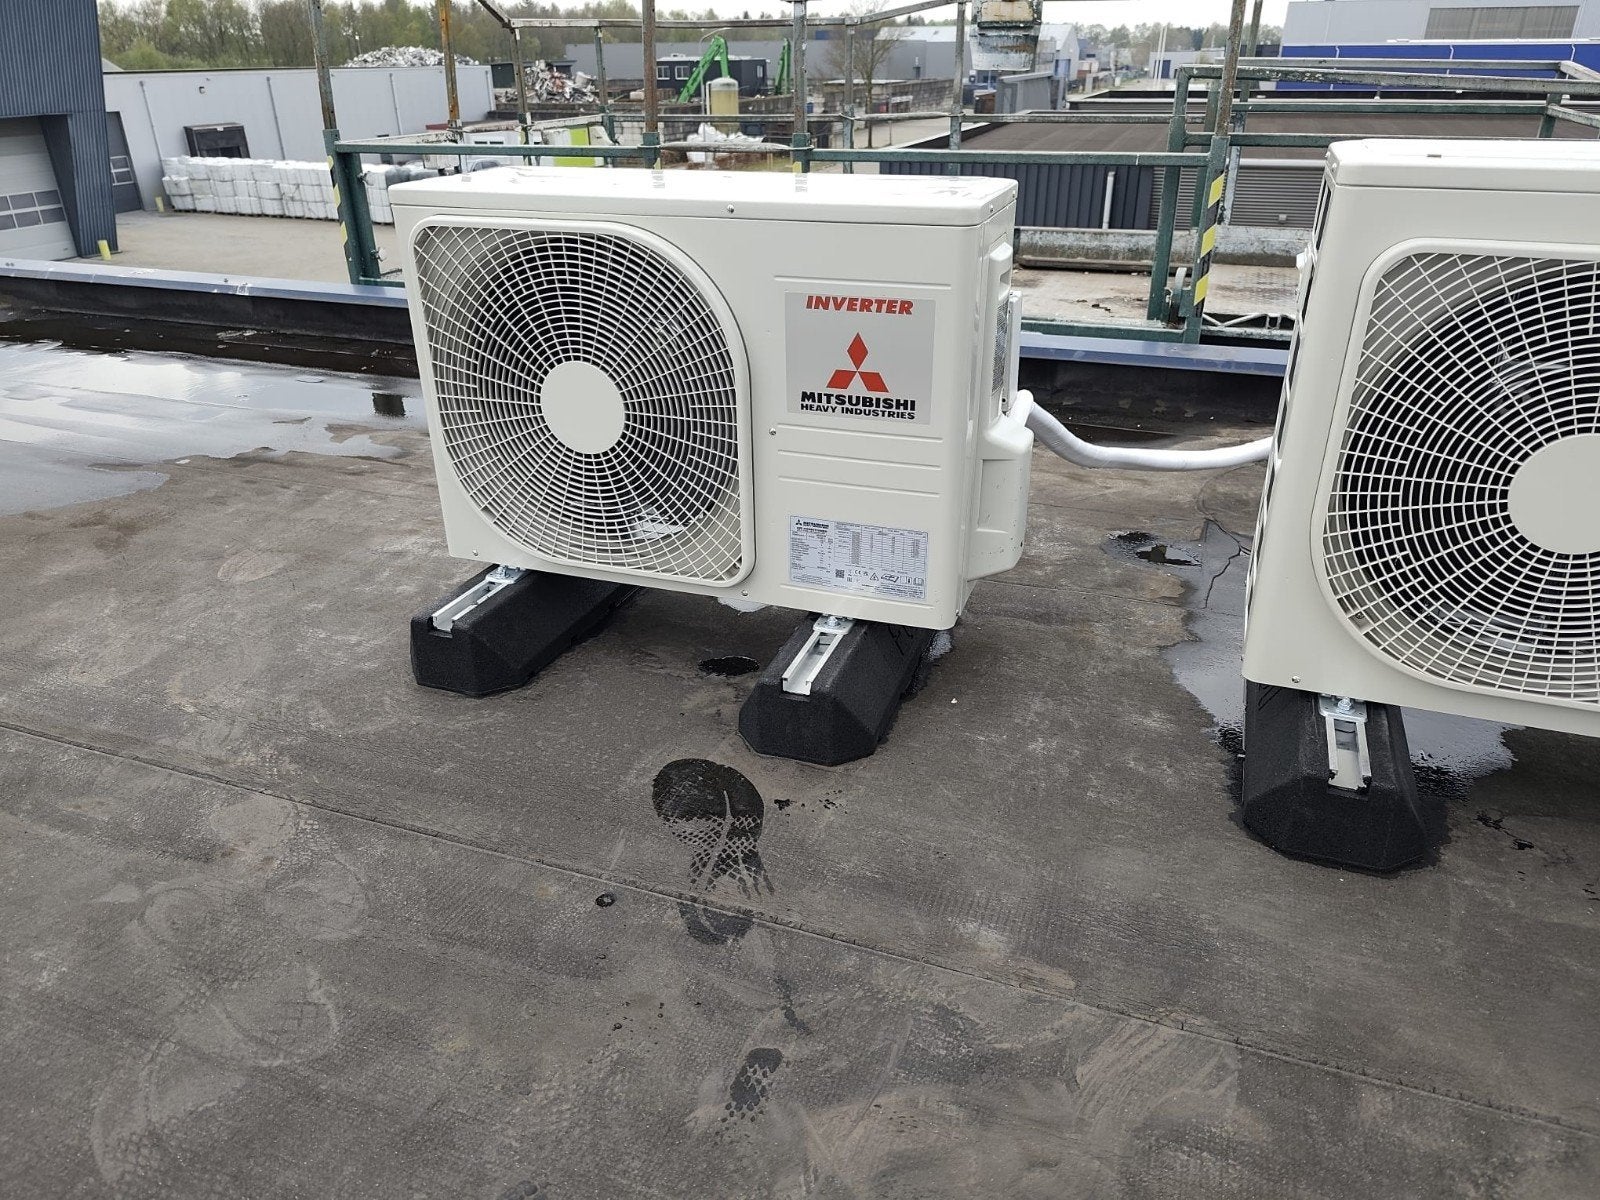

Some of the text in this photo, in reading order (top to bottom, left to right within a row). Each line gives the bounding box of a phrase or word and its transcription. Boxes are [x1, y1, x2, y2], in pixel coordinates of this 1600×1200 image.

[806, 295, 914, 315] INVERTER
[800, 403, 915, 419] HEAVY INDUSTRIES
[801, 391, 916, 411] MITSUBISHI
